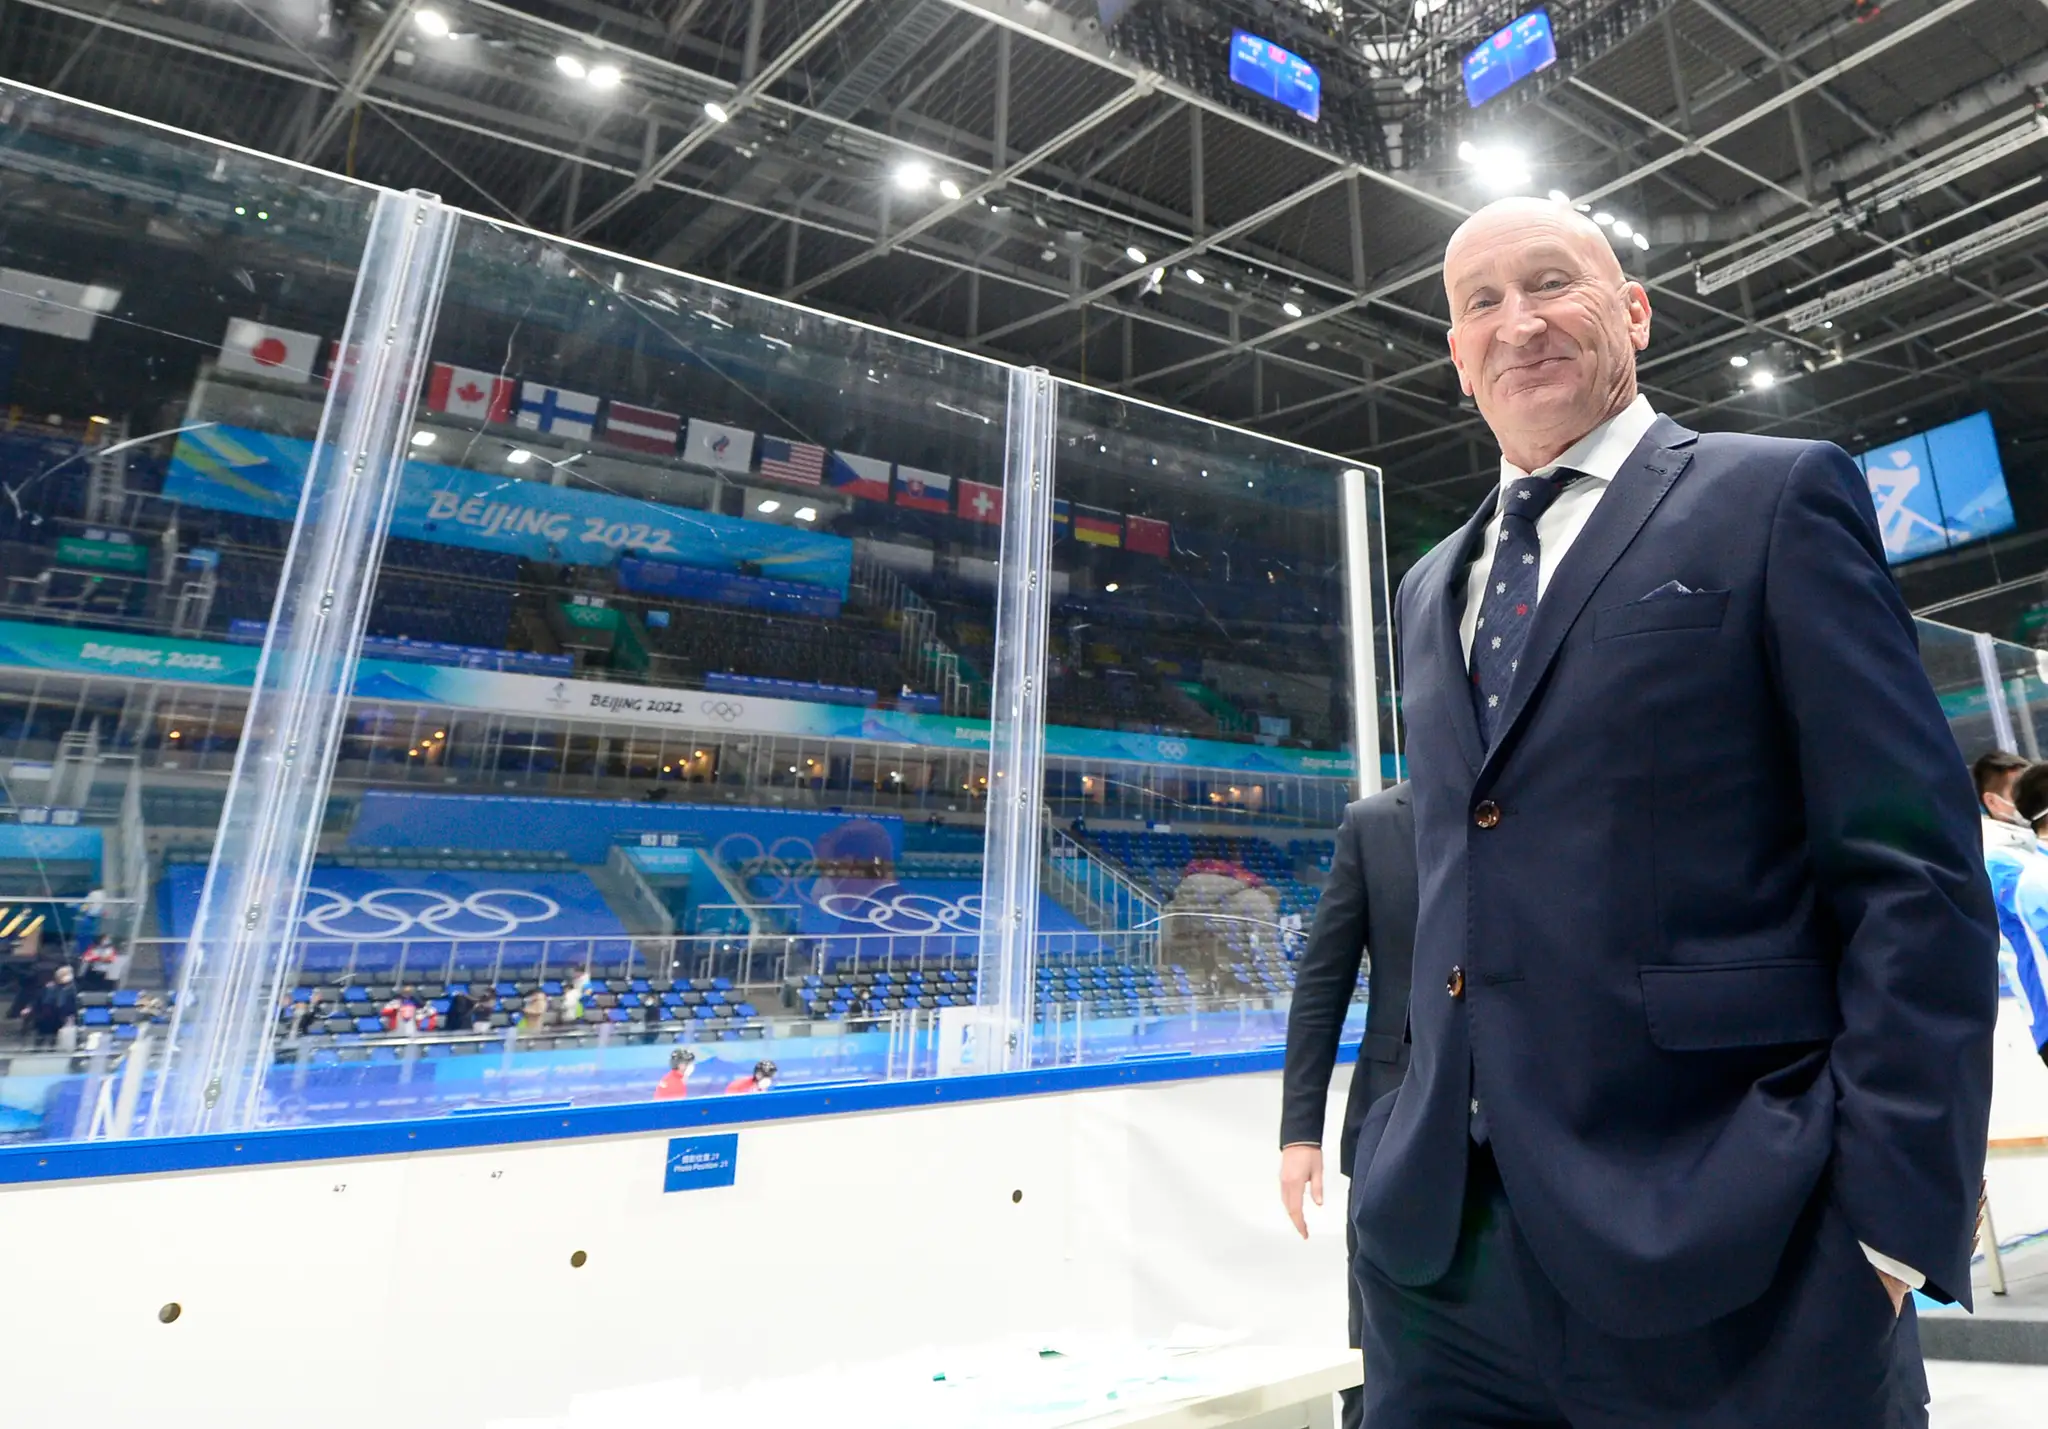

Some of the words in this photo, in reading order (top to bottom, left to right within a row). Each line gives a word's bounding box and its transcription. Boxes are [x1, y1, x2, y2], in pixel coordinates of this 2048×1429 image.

[427, 490, 572, 542] BEIJING
[579, 517, 679, 553] 2022
[165, 652, 223, 670] 2022
[590, 693, 641, 714] BEIJING
[647, 700, 685, 714] 2022
